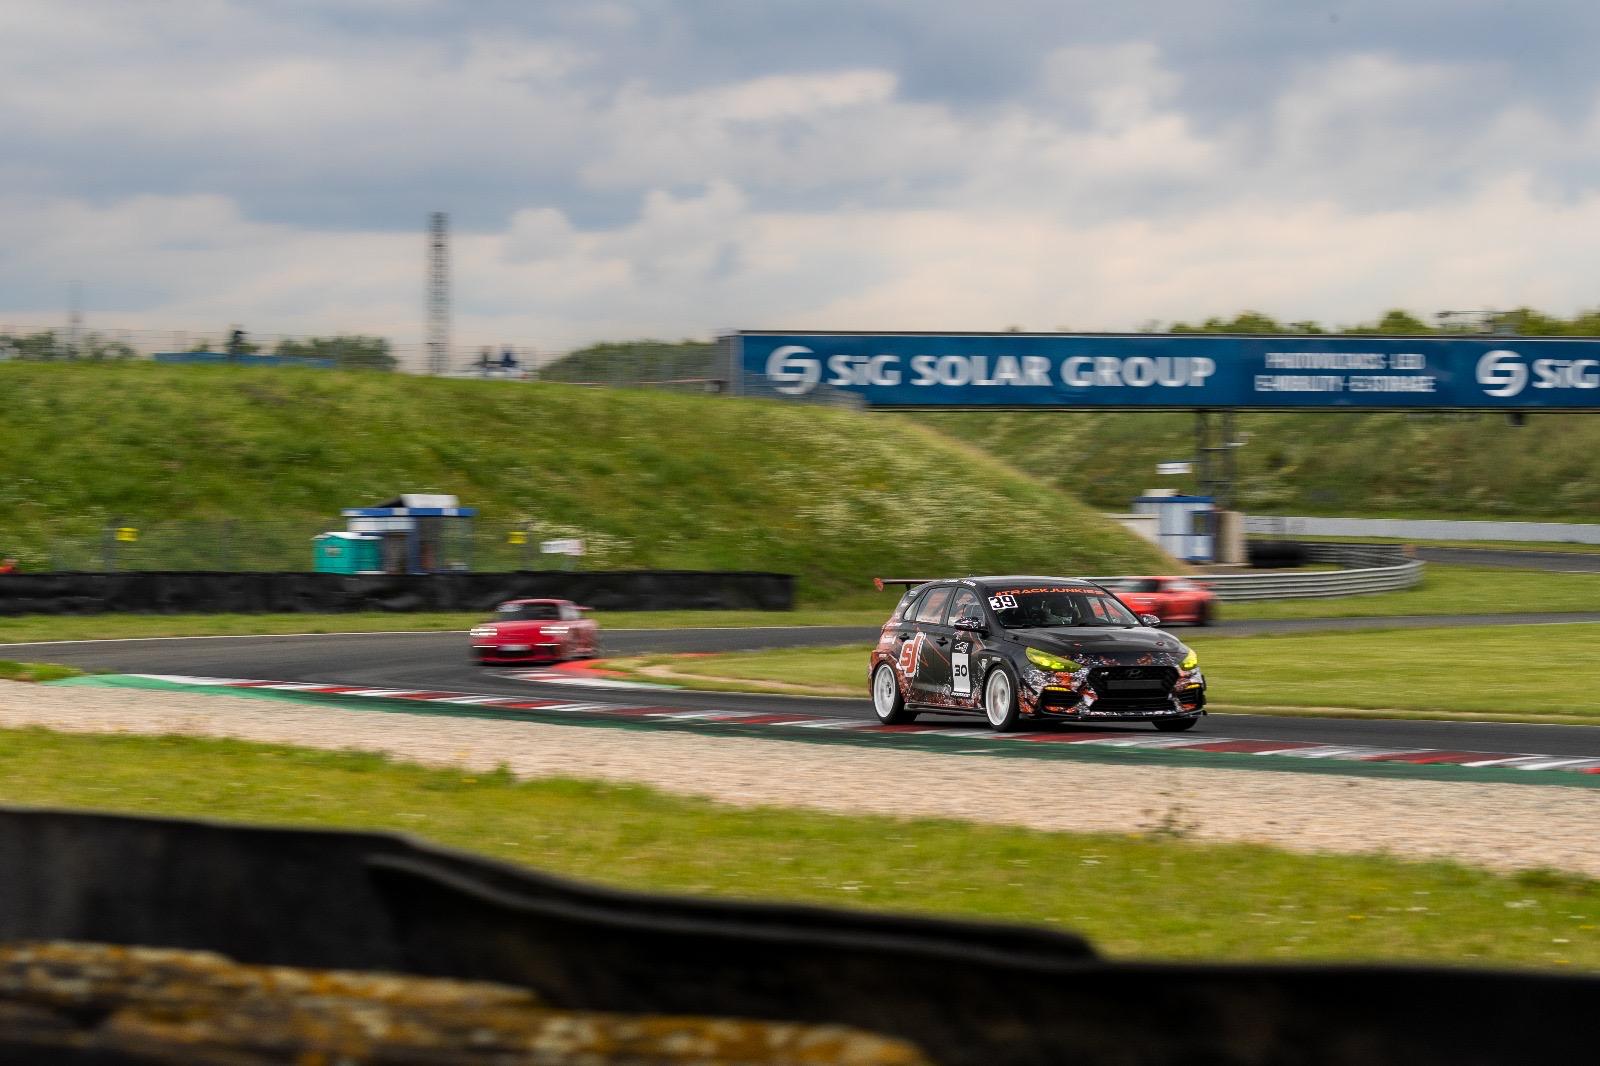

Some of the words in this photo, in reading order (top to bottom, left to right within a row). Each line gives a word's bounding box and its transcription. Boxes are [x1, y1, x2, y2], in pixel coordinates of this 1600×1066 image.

[910, 354, 1054, 387] SOLAR
[1060, 356, 1216, 388] GROUP
[995, 588, 1105, 597] #TRACKJUNKIES
[989, 594, 1017, 609] 39
[954, 664, 968, 677] 30
